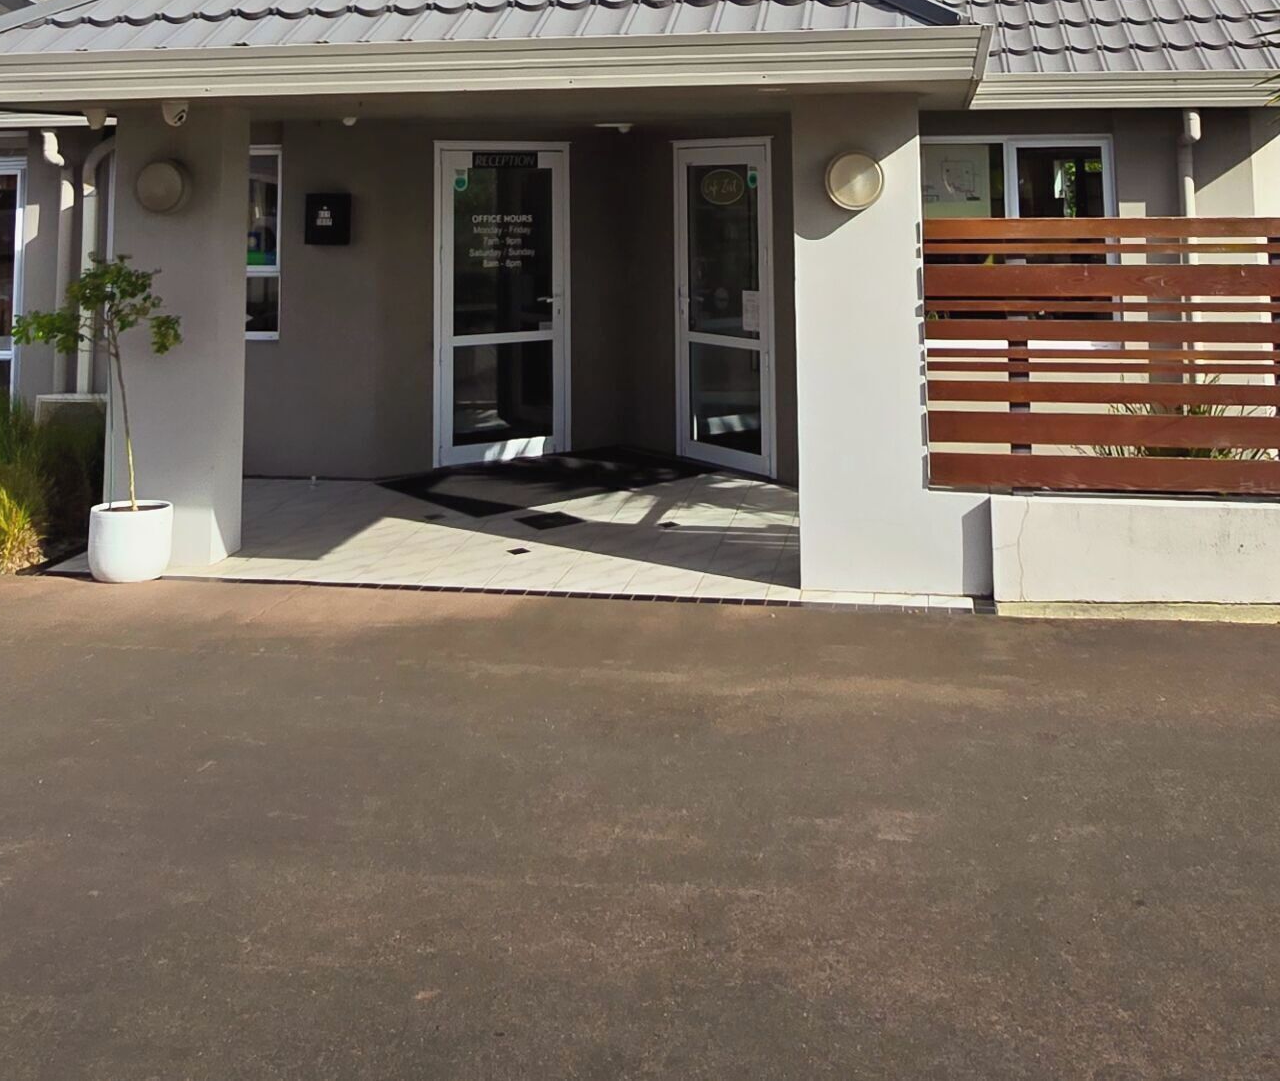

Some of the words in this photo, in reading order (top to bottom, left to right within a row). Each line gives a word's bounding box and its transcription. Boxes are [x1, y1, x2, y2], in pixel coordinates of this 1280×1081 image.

[474, 154, 535, 167] RECEPTION
[471, 214, 502, 224] OFFICE
[503, 214, 533, 223] HOURS
[473, 225, 503, 236] Monday
[508, 225, 531, 236] Friday
[468, 248, 502, 258] Saturday
[508, 248, 536, 258] Sunday
